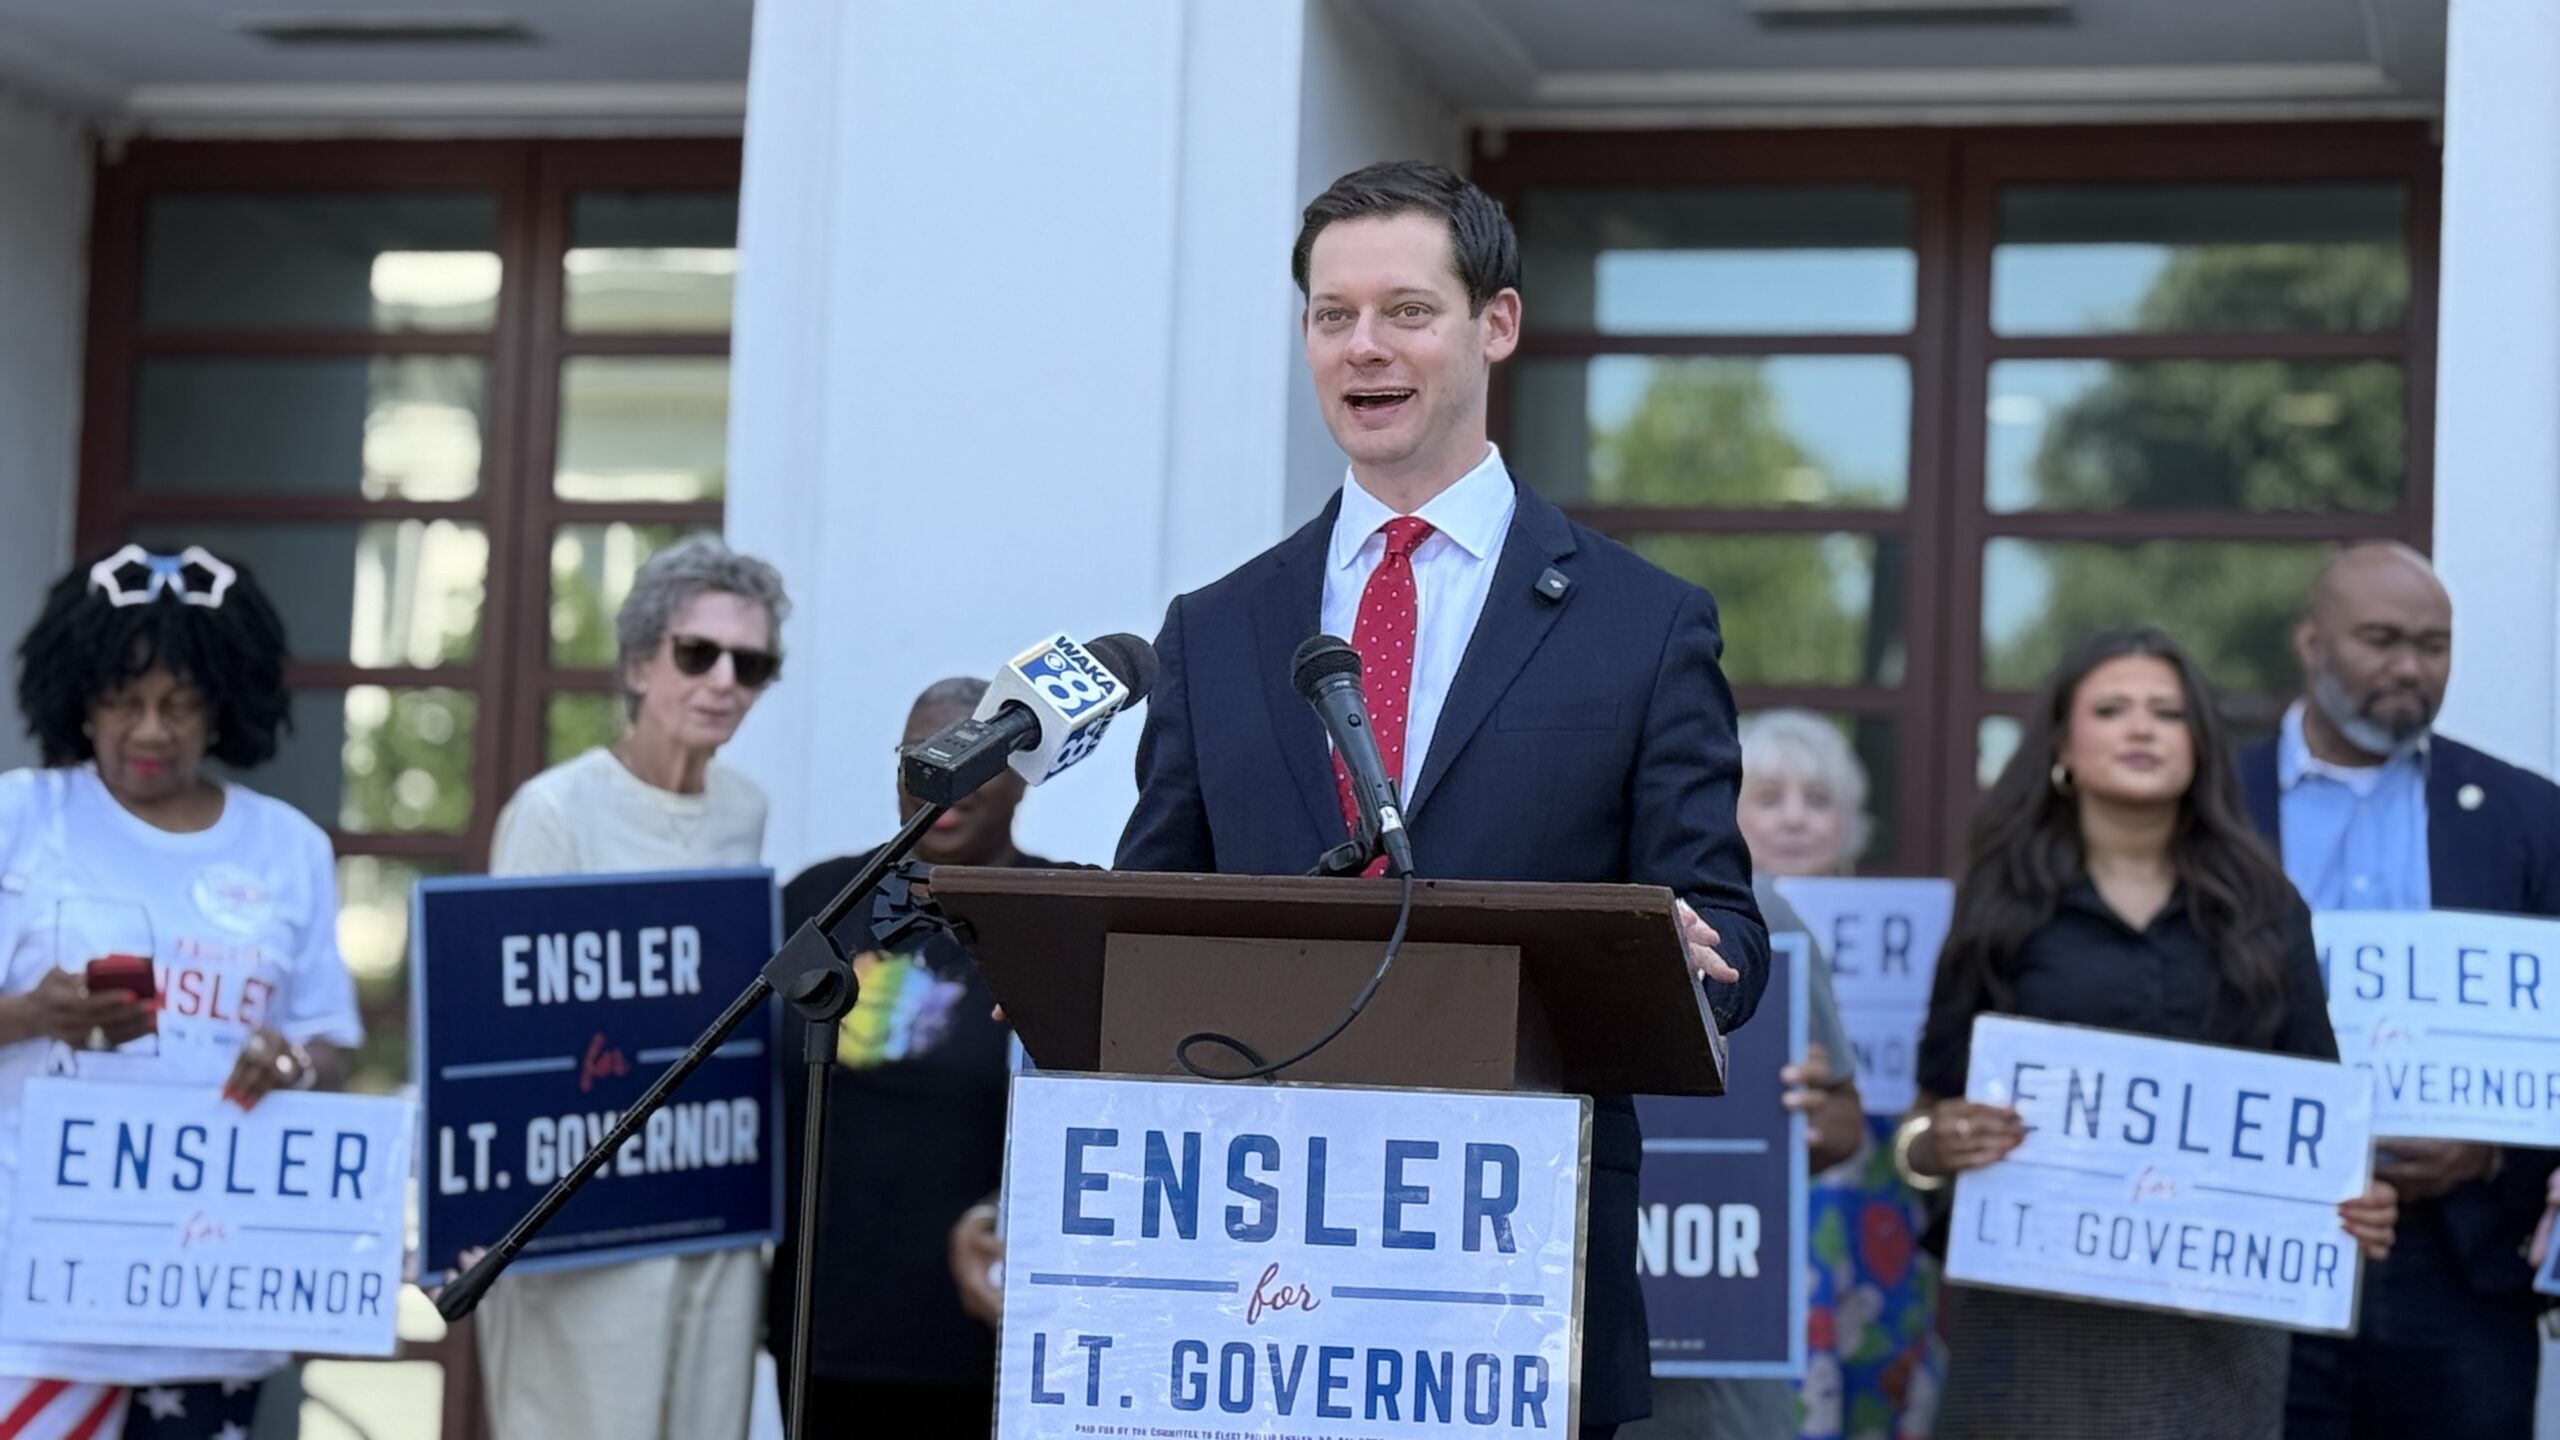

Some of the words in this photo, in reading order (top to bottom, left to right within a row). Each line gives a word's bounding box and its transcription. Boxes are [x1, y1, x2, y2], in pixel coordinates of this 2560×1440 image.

[1034, 669, 1102, 710] 8
[1055, 636, 1116, 696] WAKA
[502, 926, 701, 1007] ENSLER
[580, 1032, 629, 1093] for
[2354, 1062, 2560, 1110] VERNOR
[2010, 1062, 2326, 1169] ENSLER
[56, 1118, 368, 1200] ENSLER
[439, 1123, 511, 1195] LT.
[1061, 1127, 1520, 1254] ENSLER
[1976, 1199, 2045, 1252] LT.
[2075, 1211, 2339, 1289] GOVERNOR
[27, 1258, 96, 1305] LT.
[126, 1262, 382, 1317] GOVERNOR
[1246, 1262, 1321, 1325] for
[1031, 1332, 1132, 1409] LT.
[1171, 1339, 1550, 1429] GOVERNOR
